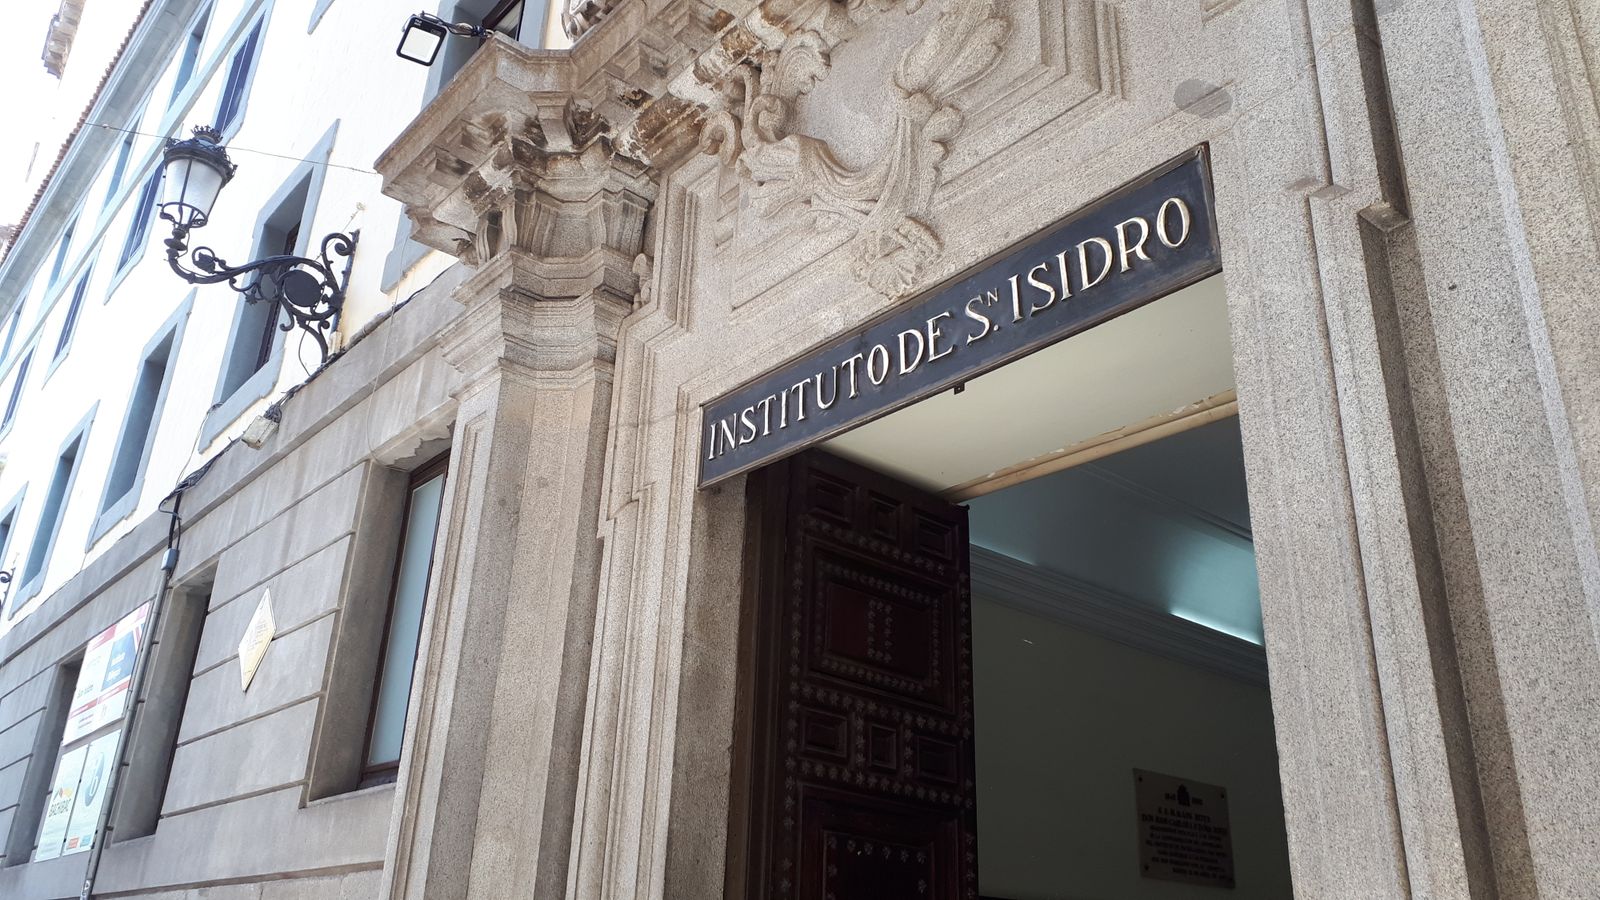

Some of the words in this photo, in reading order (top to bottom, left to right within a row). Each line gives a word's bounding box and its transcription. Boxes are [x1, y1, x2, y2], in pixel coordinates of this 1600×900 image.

[708, 343, 890, 462] INSTITUTO
[896, 310, 954, 376] DE
[1008, 196, 1192, 324] ISIDRO
